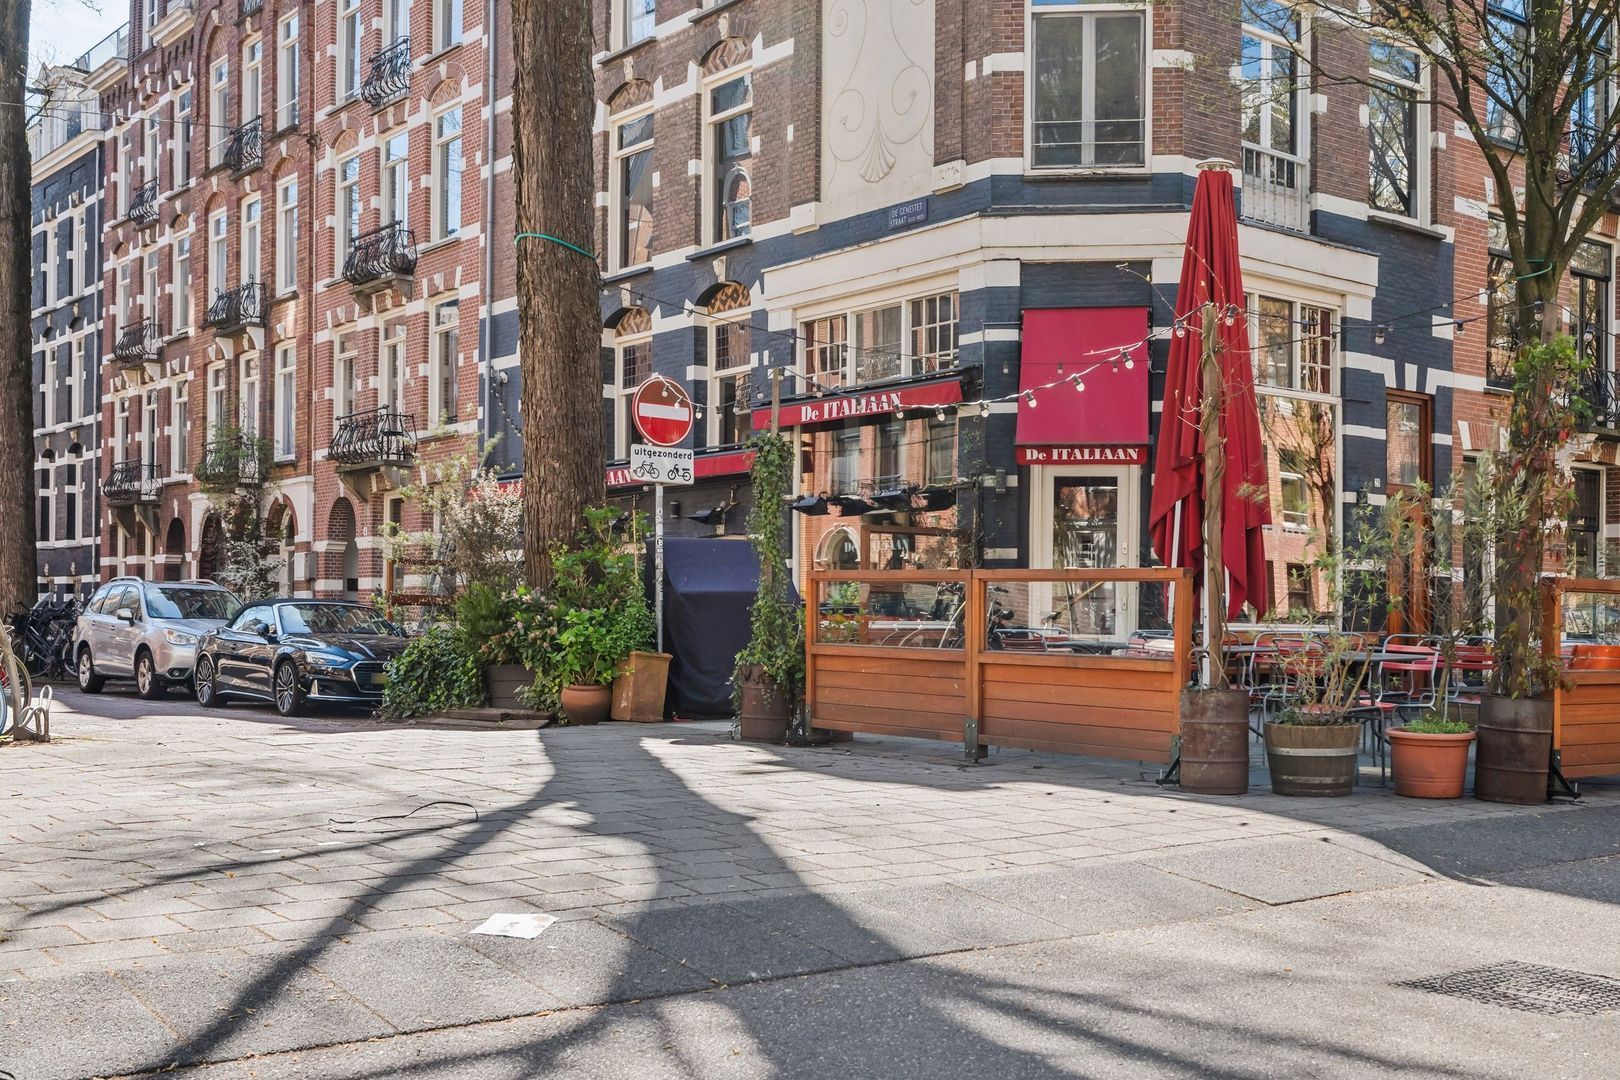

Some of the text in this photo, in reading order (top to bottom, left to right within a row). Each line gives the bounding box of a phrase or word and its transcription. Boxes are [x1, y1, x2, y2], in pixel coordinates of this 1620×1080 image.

[891, 208, 899, 218] DE
[900, 202, 923, 216] GENESTET
[890, 216, 907, 228] STRAAT
[801, 392, 902, 422] De ITALIAAN
[634, 447, 693, 460] uitgezonderd
[1025, 448, 1140, 461] De ITALIAAN
